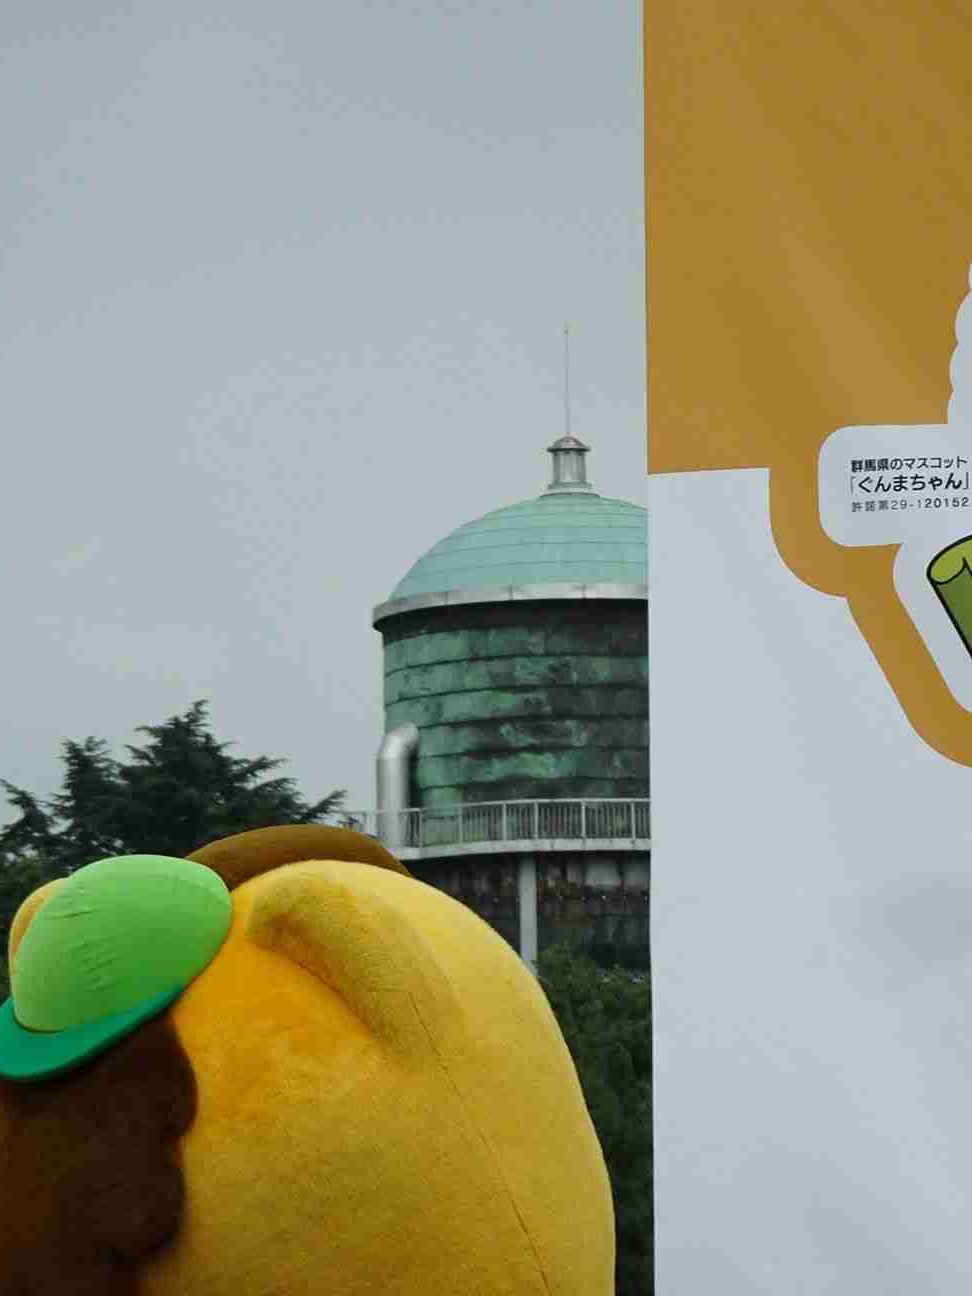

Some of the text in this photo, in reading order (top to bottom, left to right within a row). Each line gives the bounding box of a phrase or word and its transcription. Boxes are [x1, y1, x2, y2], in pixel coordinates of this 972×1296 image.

[850, 456, 968, 473] 群馬県のマスコット
[850, 472, 969, 494] 「ぐんまちゃん」
